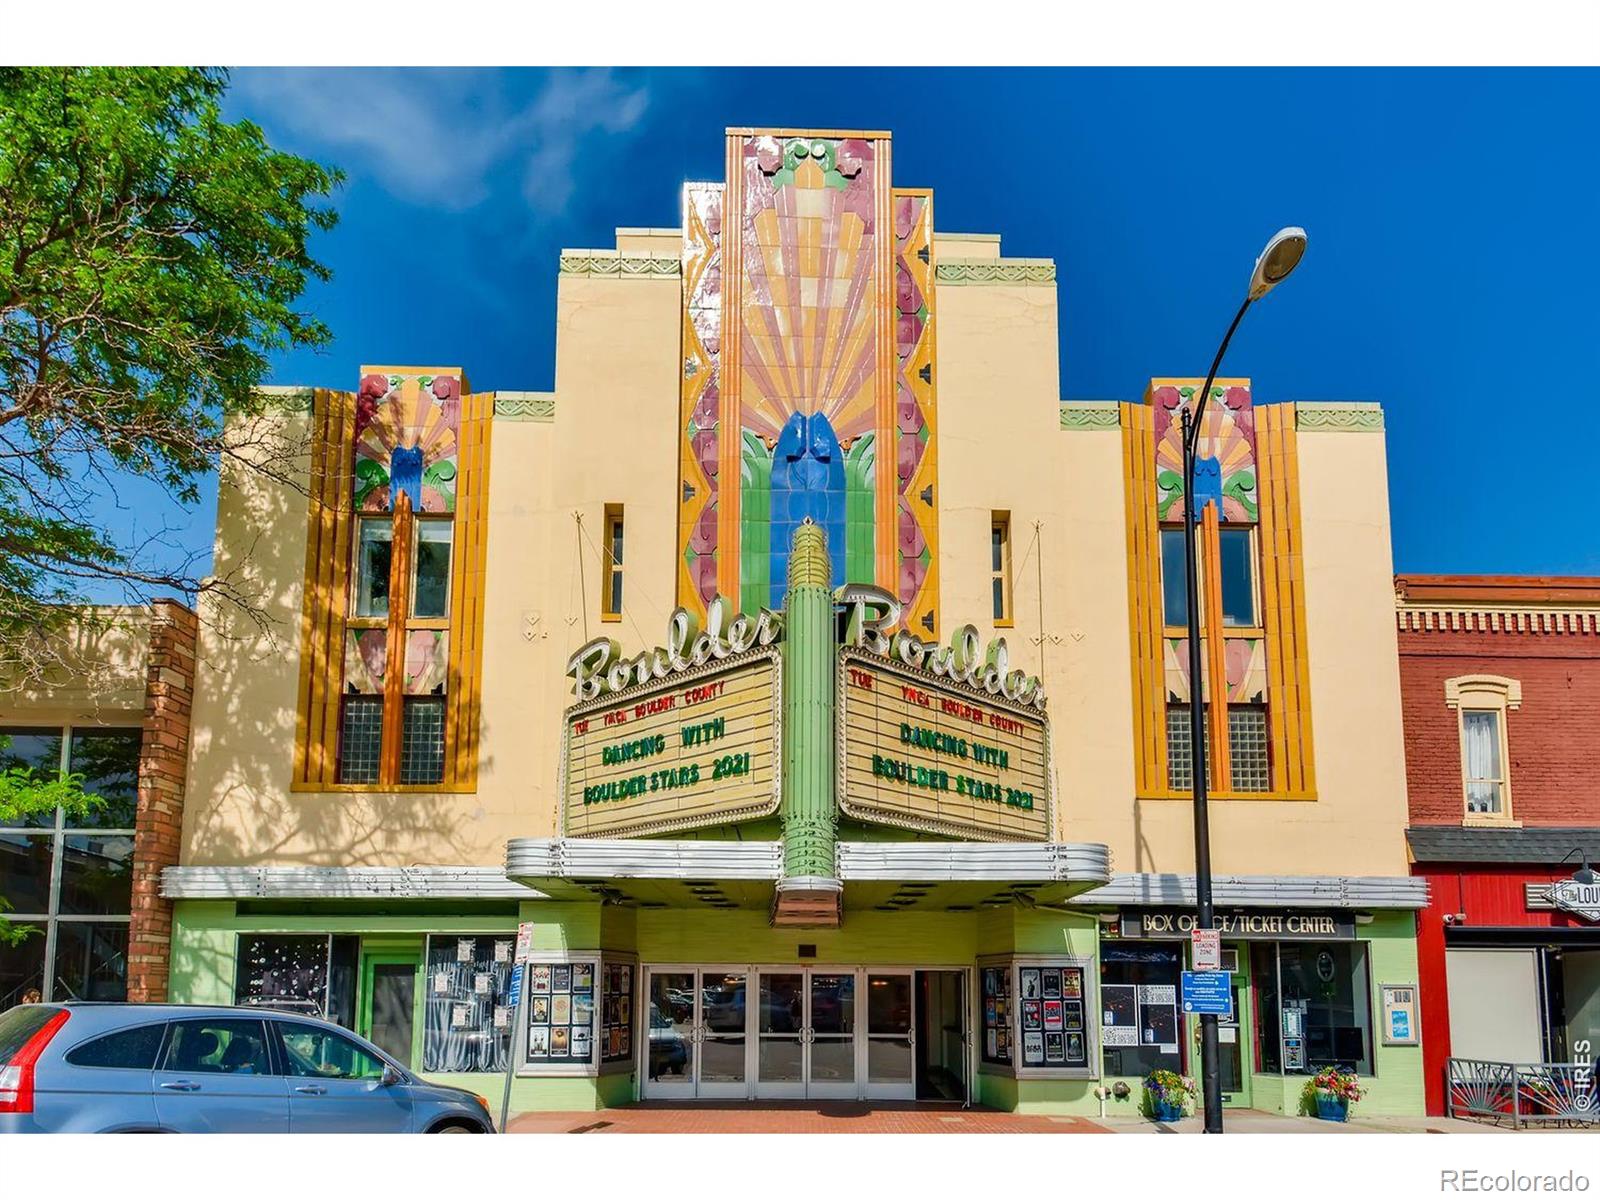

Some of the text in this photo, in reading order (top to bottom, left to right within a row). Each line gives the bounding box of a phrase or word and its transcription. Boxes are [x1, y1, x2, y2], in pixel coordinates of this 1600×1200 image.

[566, 592, 785, 701] Boulder
[834, 583, 1048, 711] Boulder
[634, 695, 676, 718] BOULDER
[685, 680, 725, 704] COUNTY
[941, 699, 983, 724] BOULDER
[990, 713, 1024, 737] COUNTY
[602, 716, 725, 766] DANCING WITH
[900, 722, 1009, 770] DANCING WITH
[583, 752, 750, 806] BOULDER STARS 2021
[871, 754, 1034, 812] BOULDER STARS 2021
[1577, 887, 1600, 904] LOU
[1143, 915, 1336, 933] BOX OFCE/TICKET CENTER
